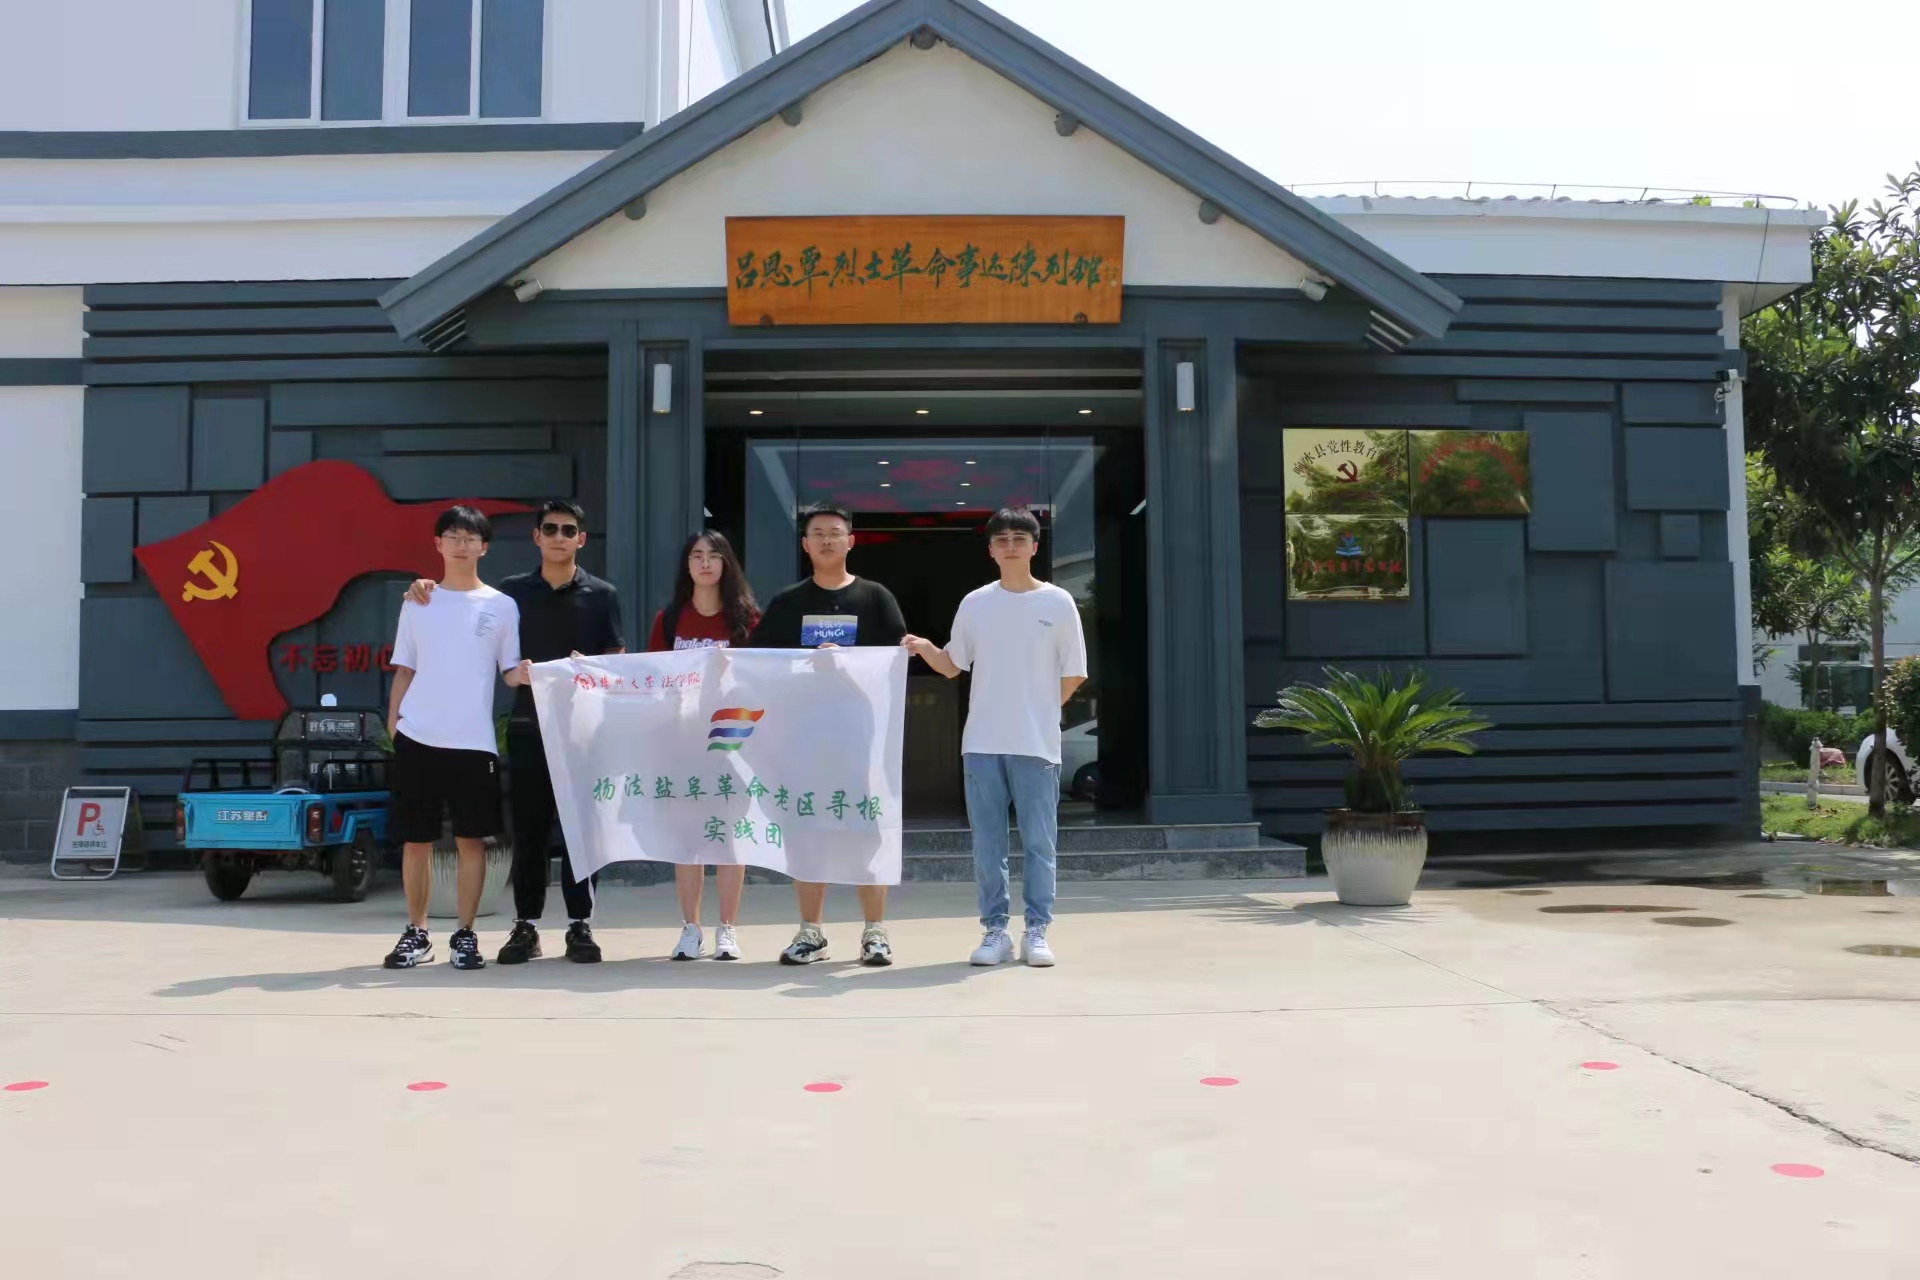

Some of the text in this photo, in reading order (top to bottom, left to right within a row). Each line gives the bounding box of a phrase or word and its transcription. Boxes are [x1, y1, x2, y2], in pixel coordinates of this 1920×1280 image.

[279, 643, 400, 673] 不忘初心
[592, 773, 884, 821] 扬法盐阜革命老区寻根
[76, 802, 101, 836] P
[703, 816, 783, 849] 实践团
